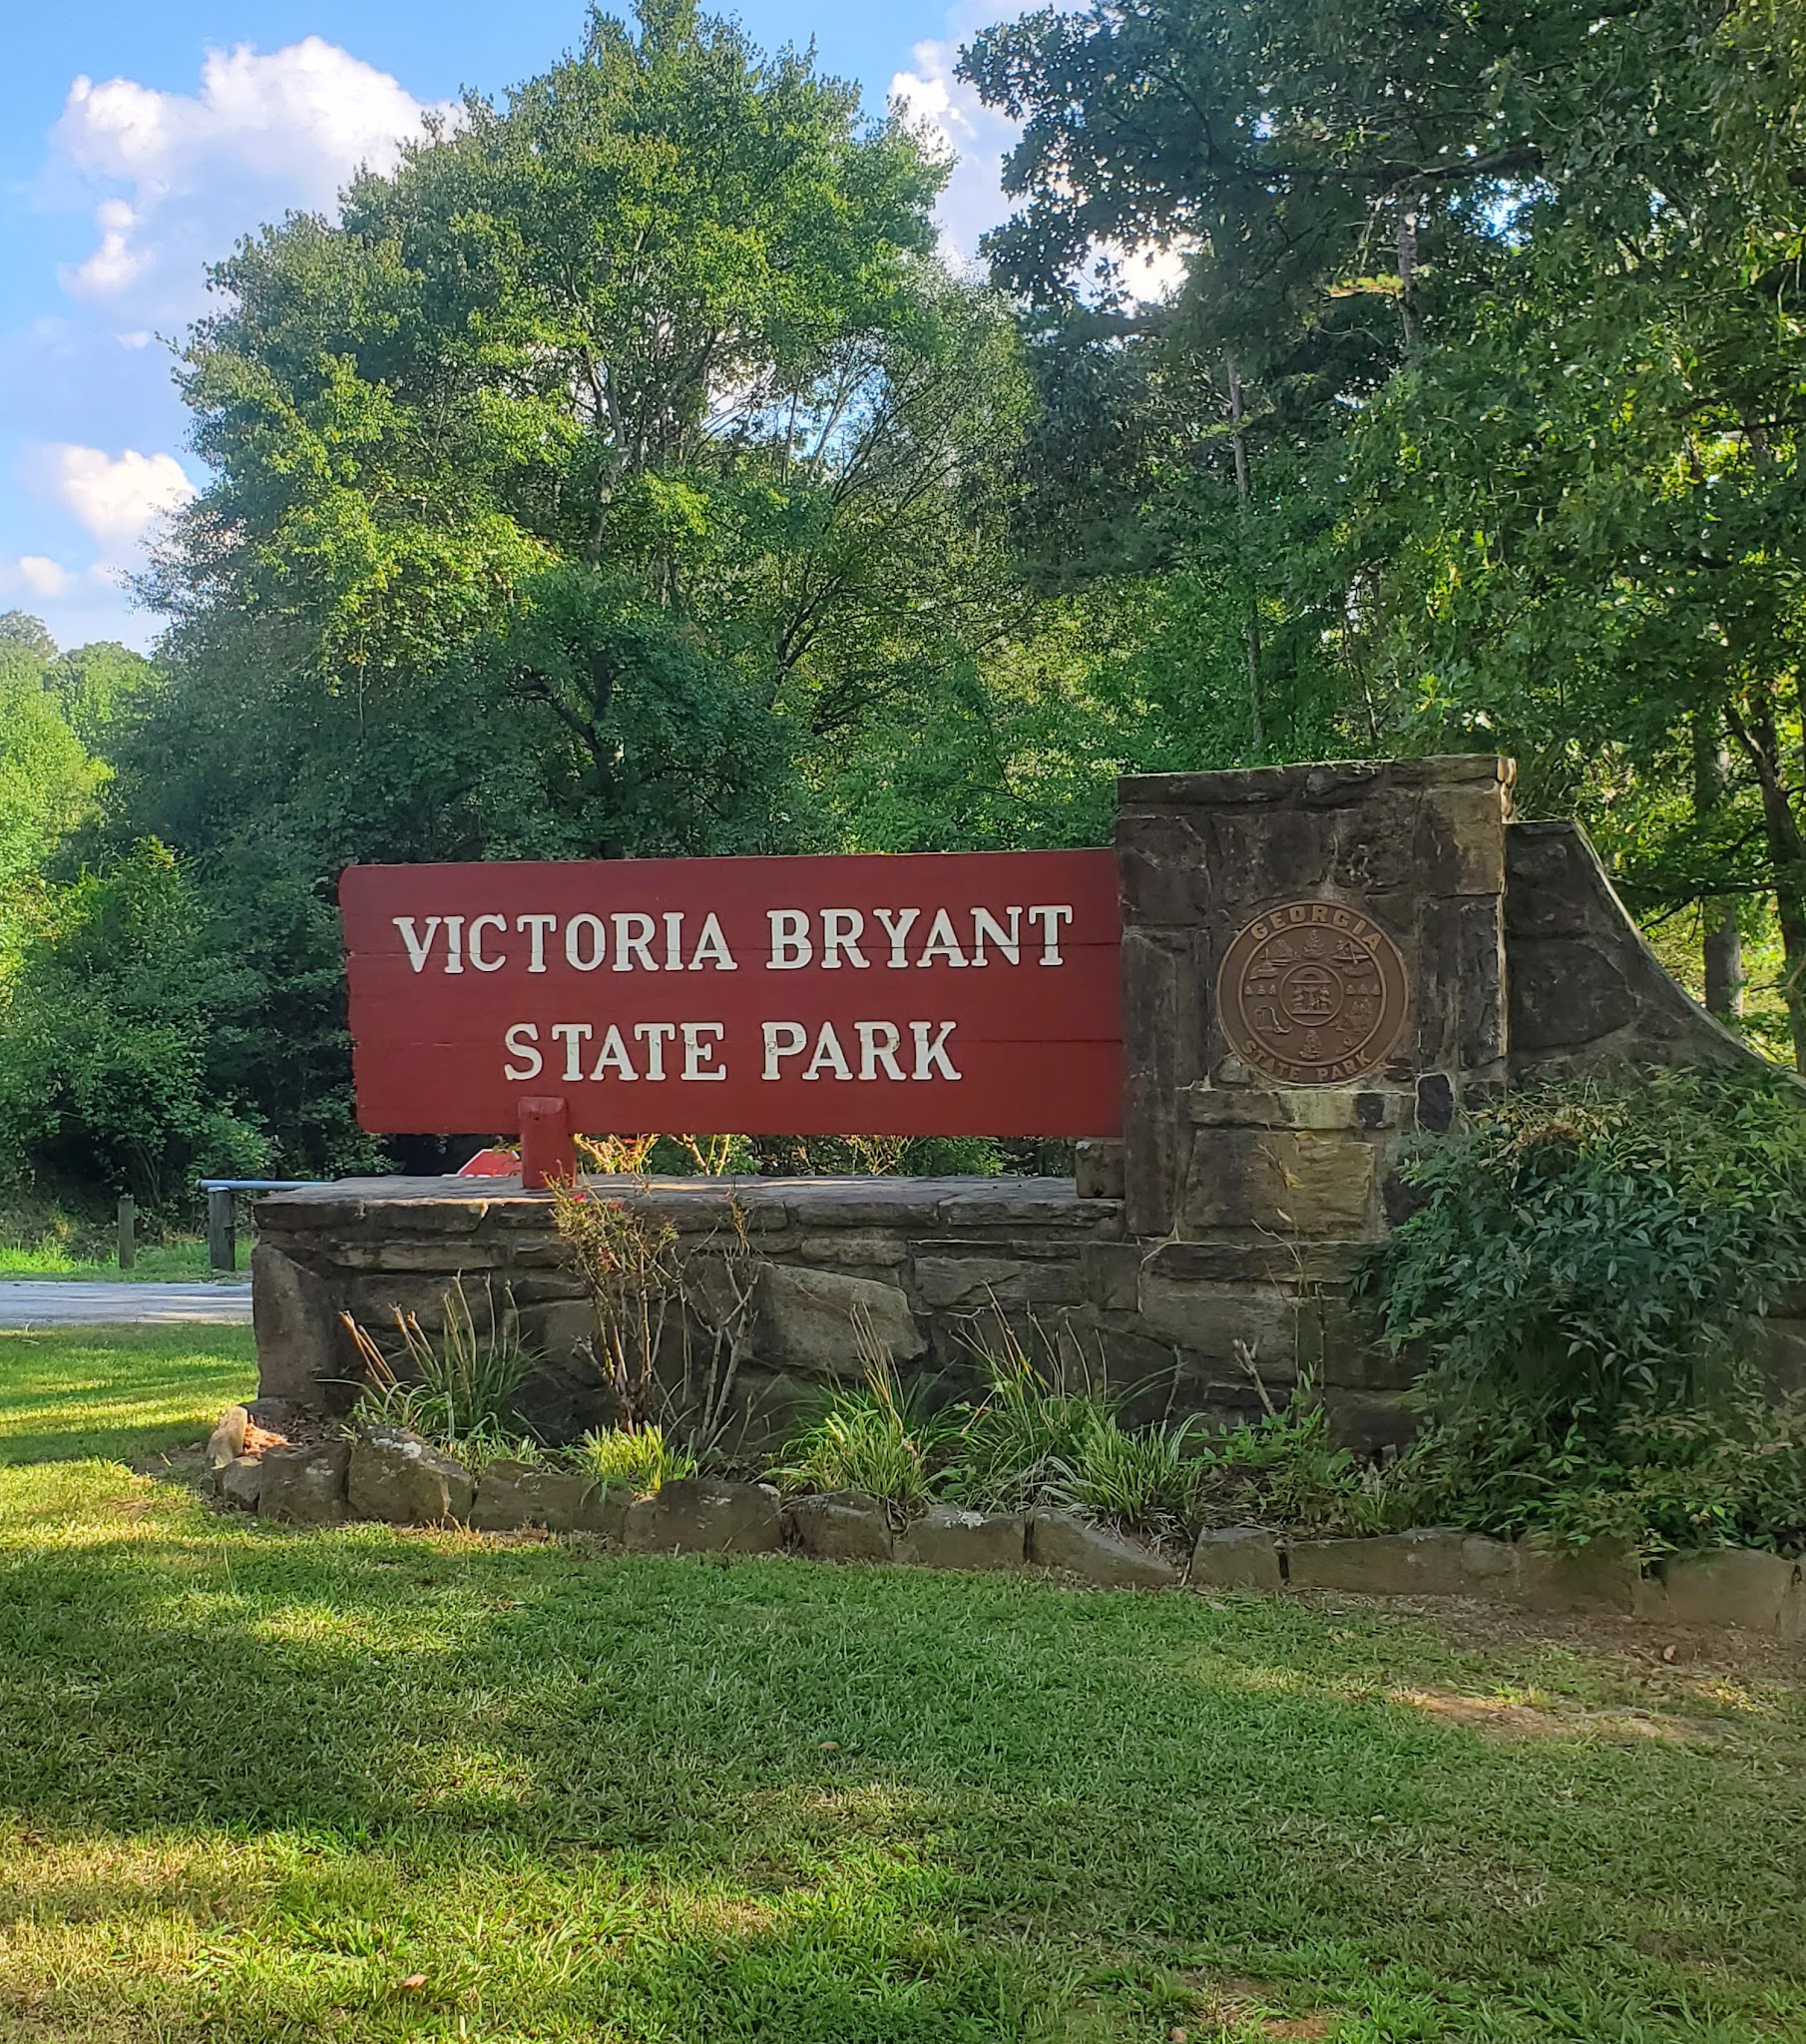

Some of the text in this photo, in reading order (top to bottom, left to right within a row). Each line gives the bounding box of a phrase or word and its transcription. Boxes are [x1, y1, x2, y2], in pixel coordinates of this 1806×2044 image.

[392, 904, 1073, 974] VICTORIA BRYANT
[1250, 903, 1384, 952] GEORGIA
[503, 1020, 962, 1082] STATE PARK
[1241, 1039, 1374, 1082] STATE PARK
